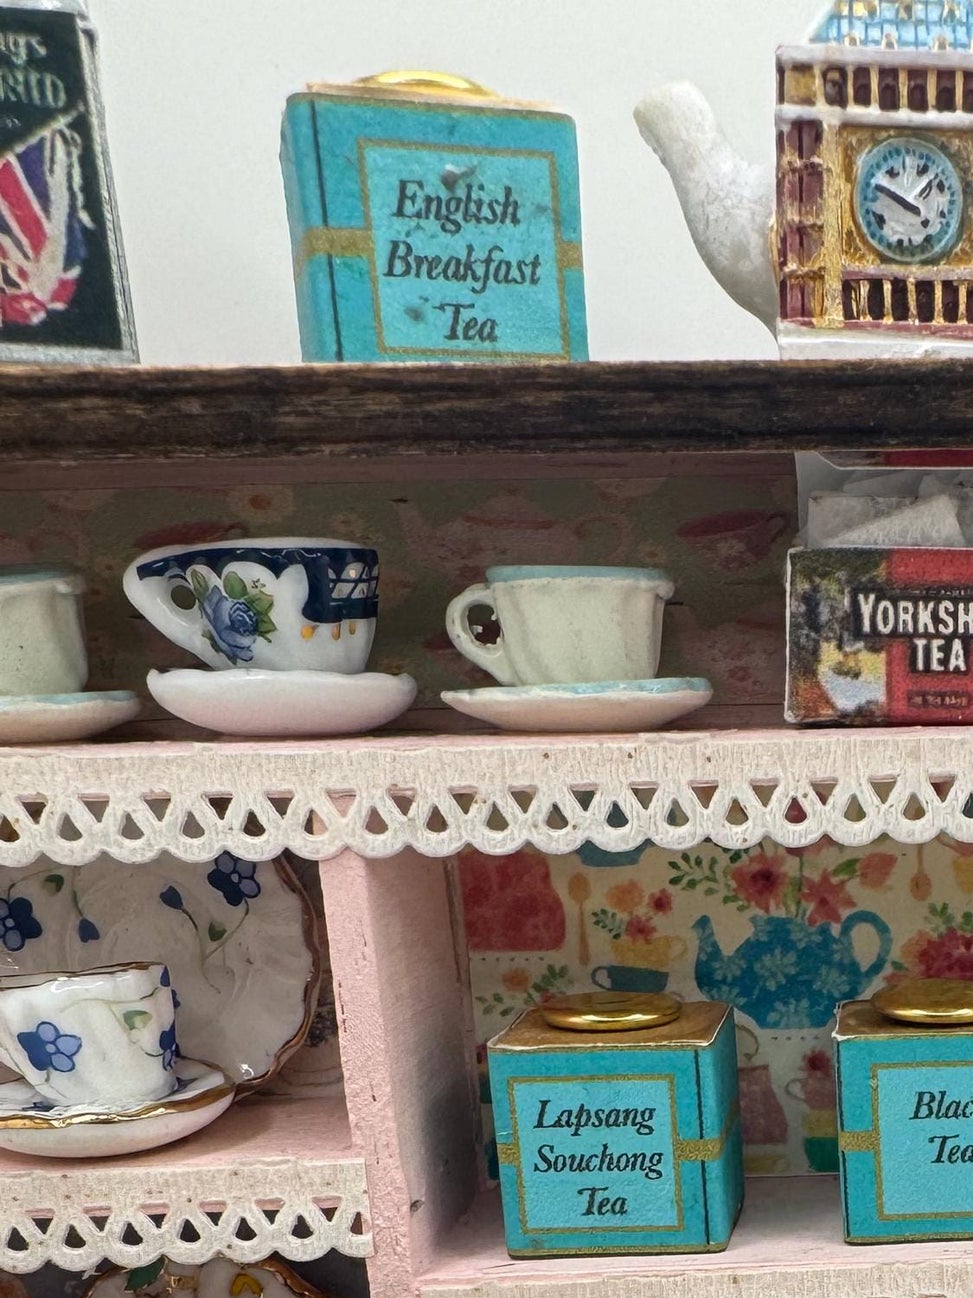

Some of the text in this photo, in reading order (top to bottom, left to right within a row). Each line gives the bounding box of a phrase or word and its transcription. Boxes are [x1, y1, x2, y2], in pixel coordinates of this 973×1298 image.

[391, 178, 521, 235] English
[383, 239, 542, 294] Breakfast
[432, 302, 499, 343] Tea
[913, 638, 967, 672] TEA
[533, 1099, 656, 1137] Lapsang
[533, 1142, 664, 1180] Souchong
[577, 1186, 629, 1217] Tea
